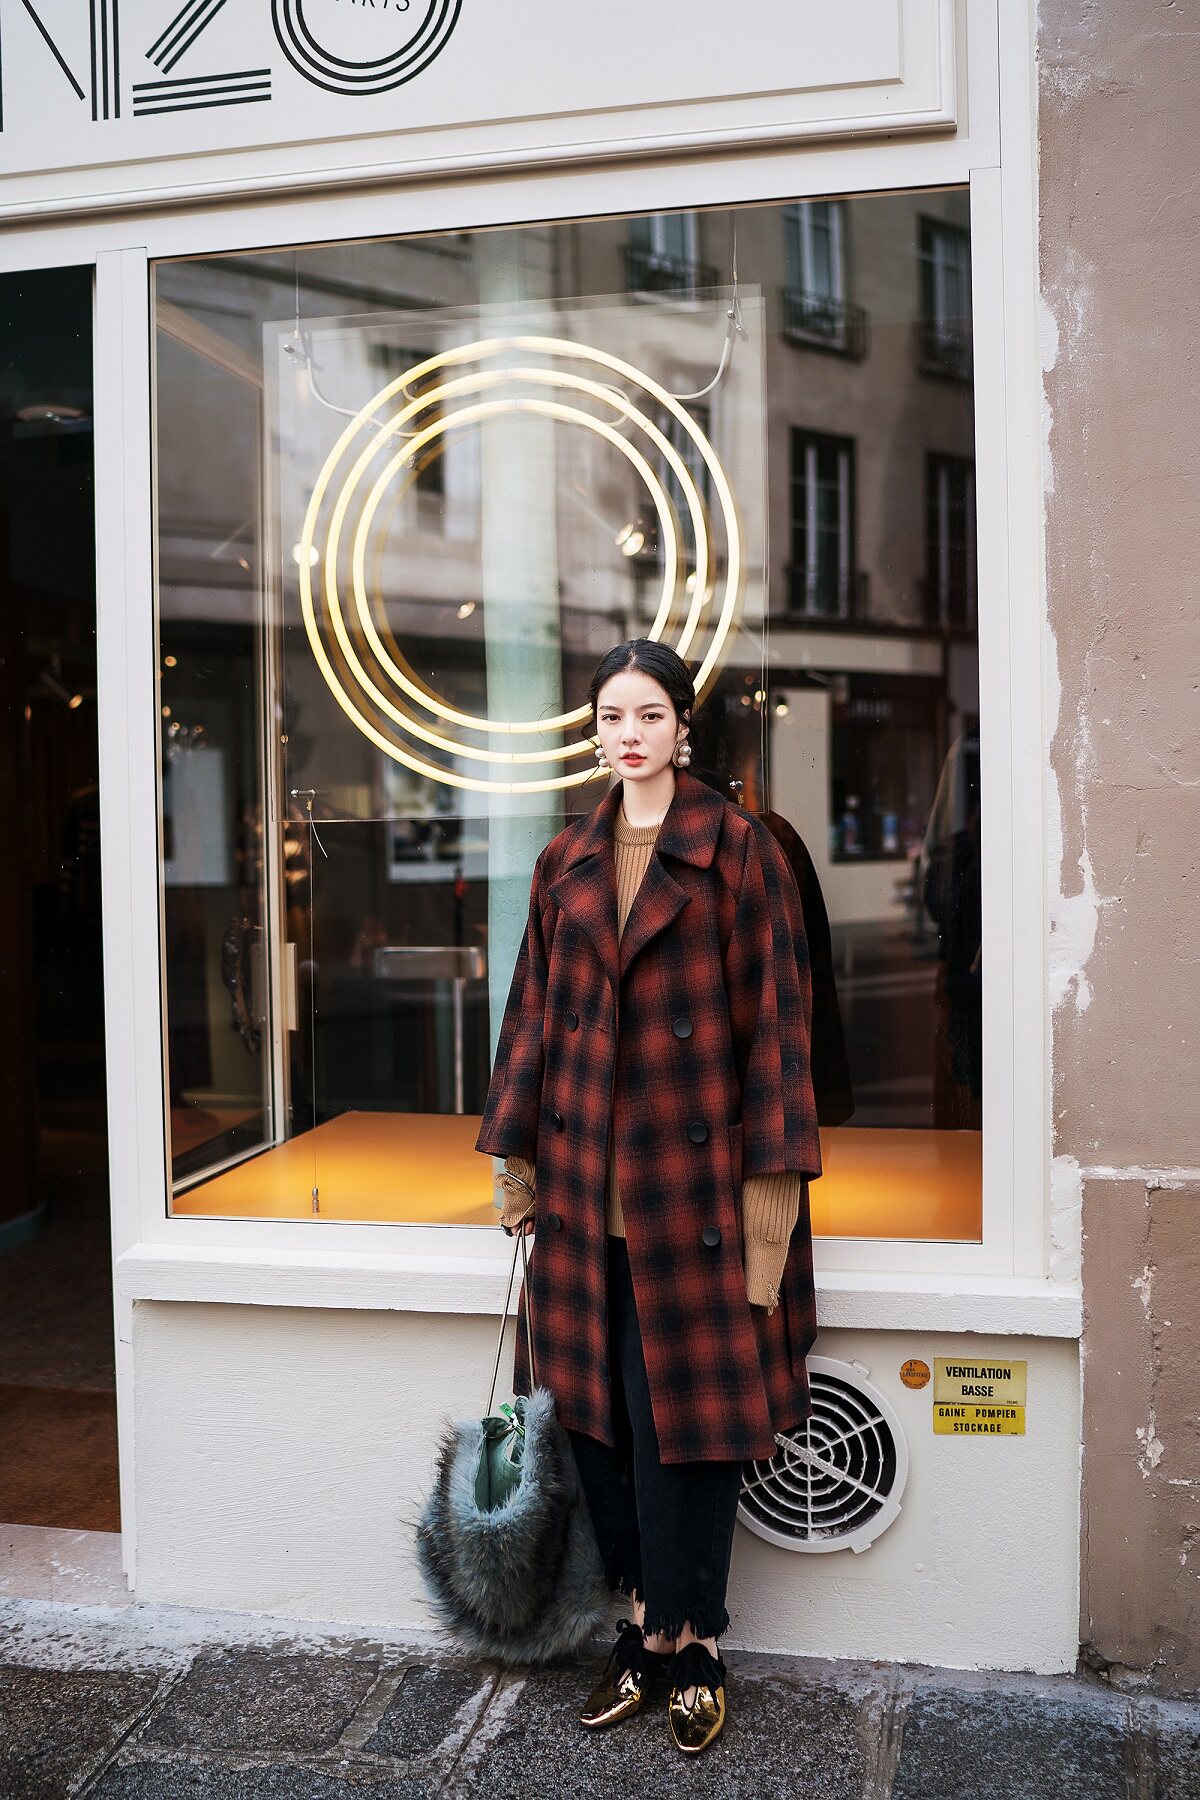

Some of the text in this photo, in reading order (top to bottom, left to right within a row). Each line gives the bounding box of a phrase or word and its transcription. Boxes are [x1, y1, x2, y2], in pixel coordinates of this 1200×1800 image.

[945, 1366, 1011, 1379] VENTILATION
[961, 1385, 994, 1397] BASSE
[938, 1408, 1016, 1418] GAINE POMPIER
[953, 1422, 1002, 1433] STOCKAGE
